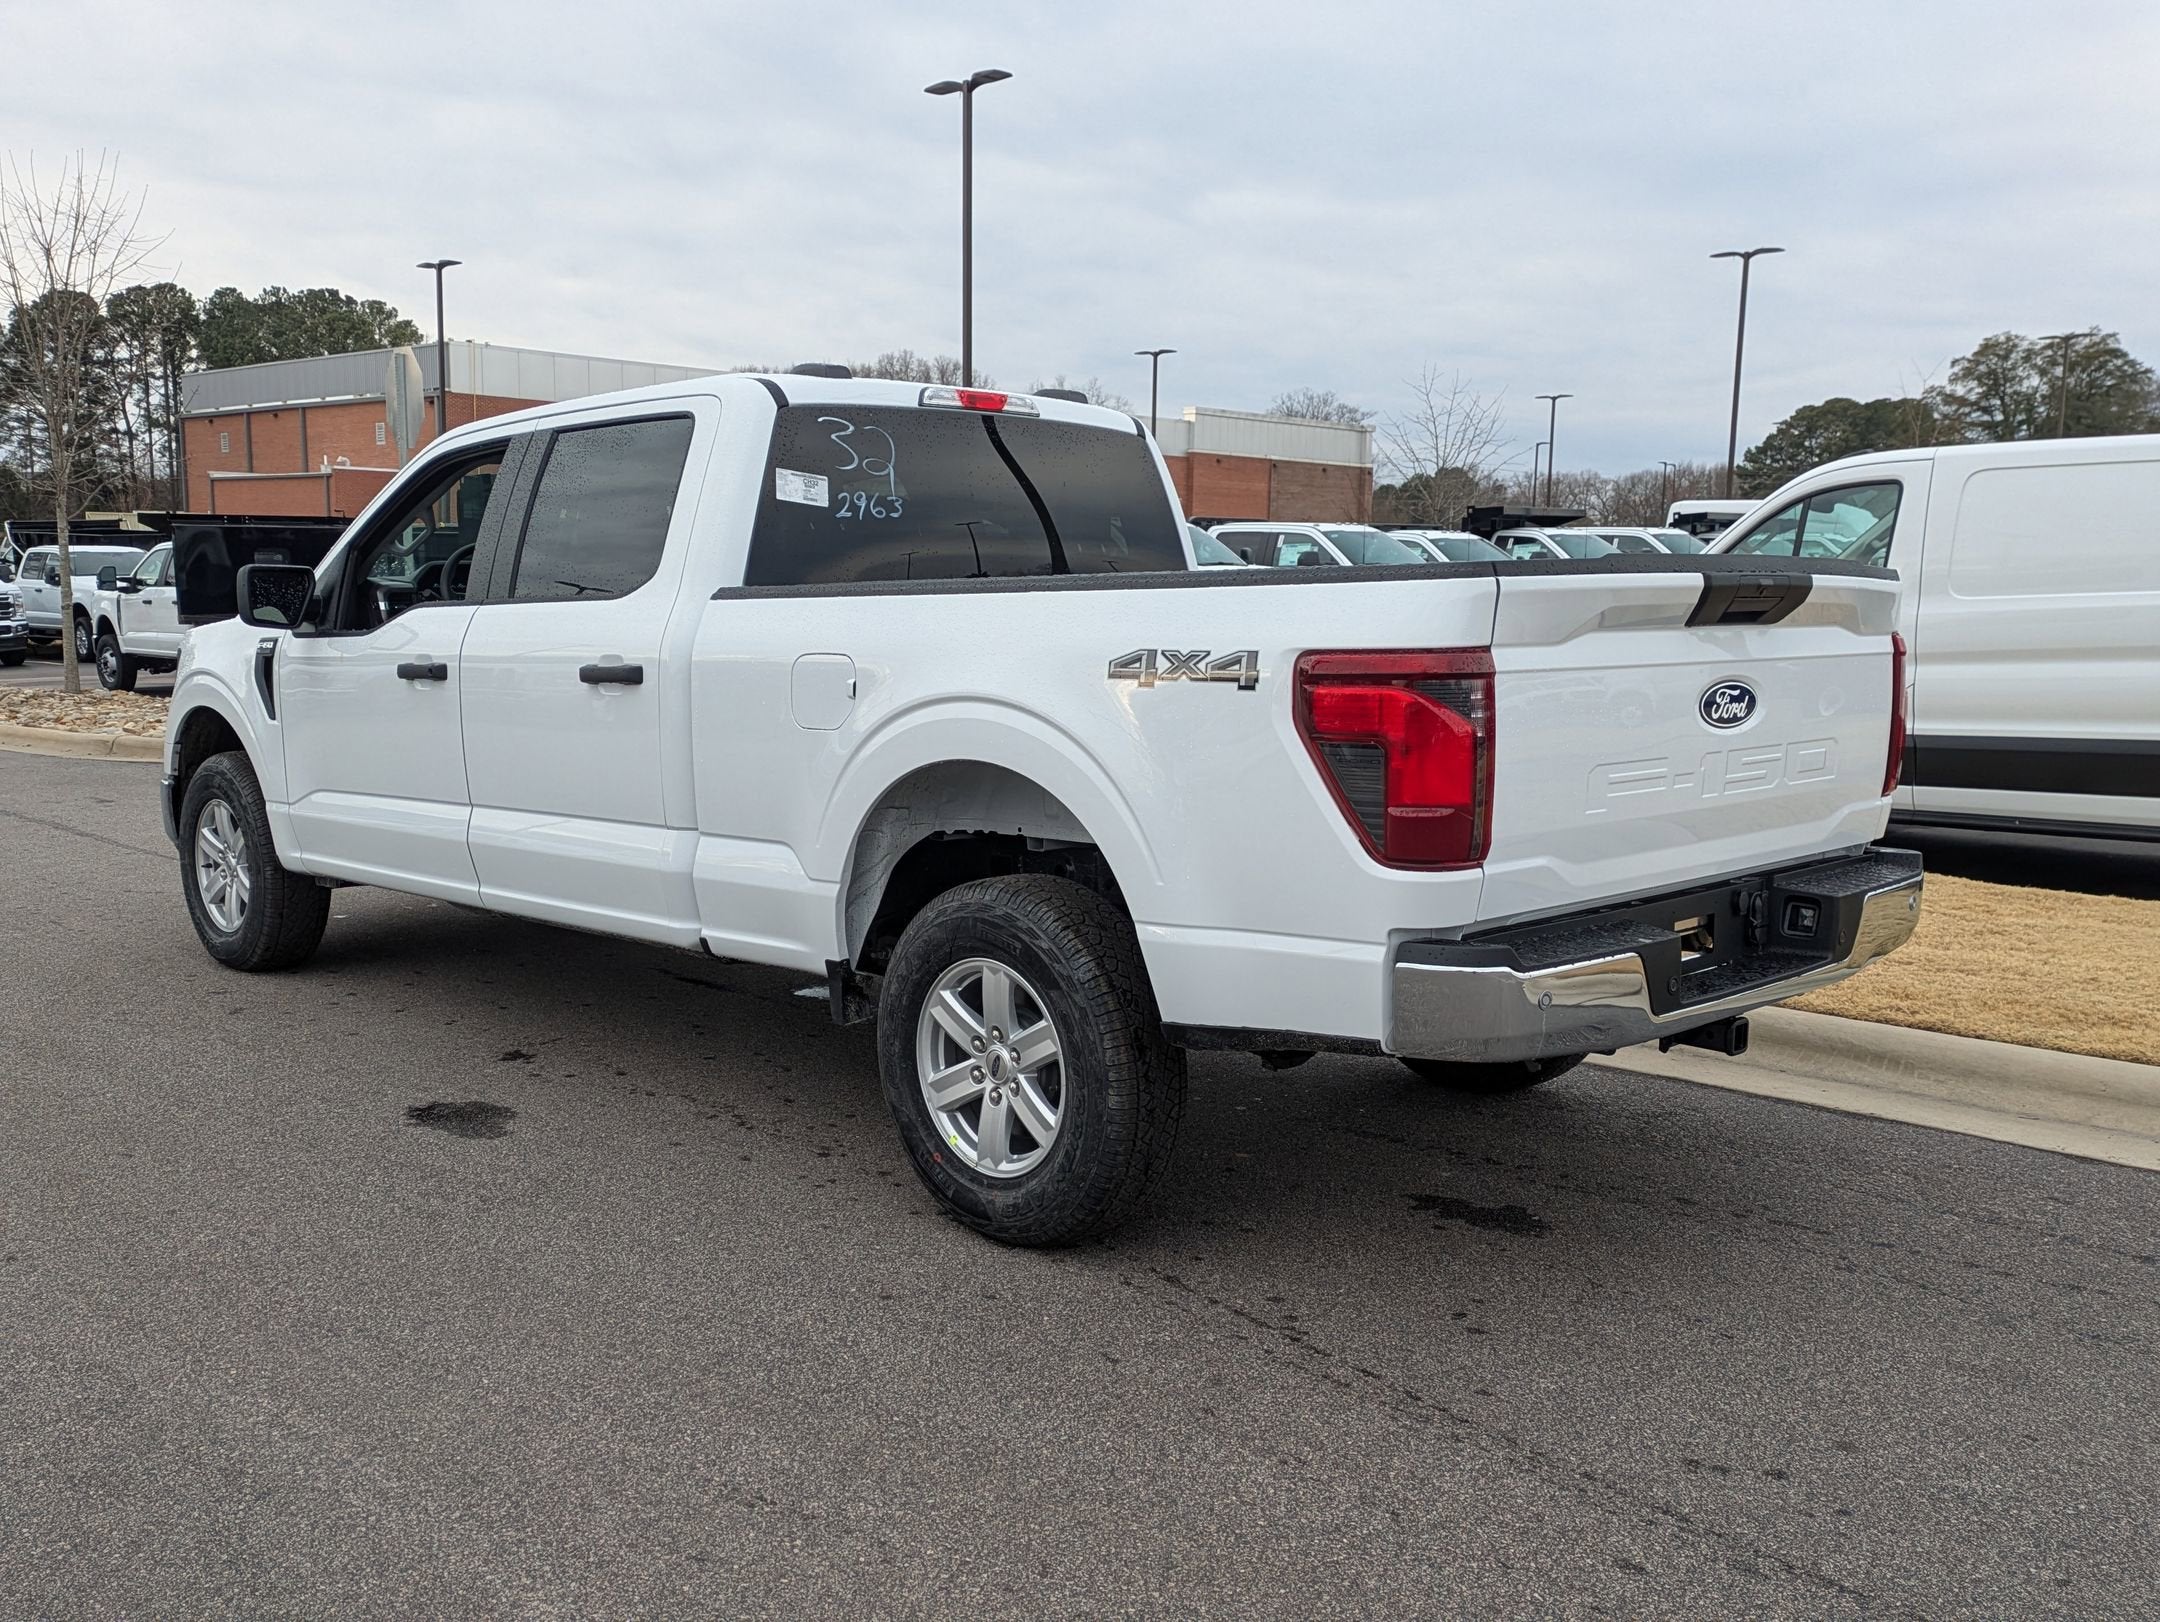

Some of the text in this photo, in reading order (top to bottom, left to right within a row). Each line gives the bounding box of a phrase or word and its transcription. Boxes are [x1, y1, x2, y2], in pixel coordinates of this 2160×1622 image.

[835, 490, 903, 520] 2963
[1711, 688, 1749, 720] Ford
[1584, 736, 1839, 814] F-150
